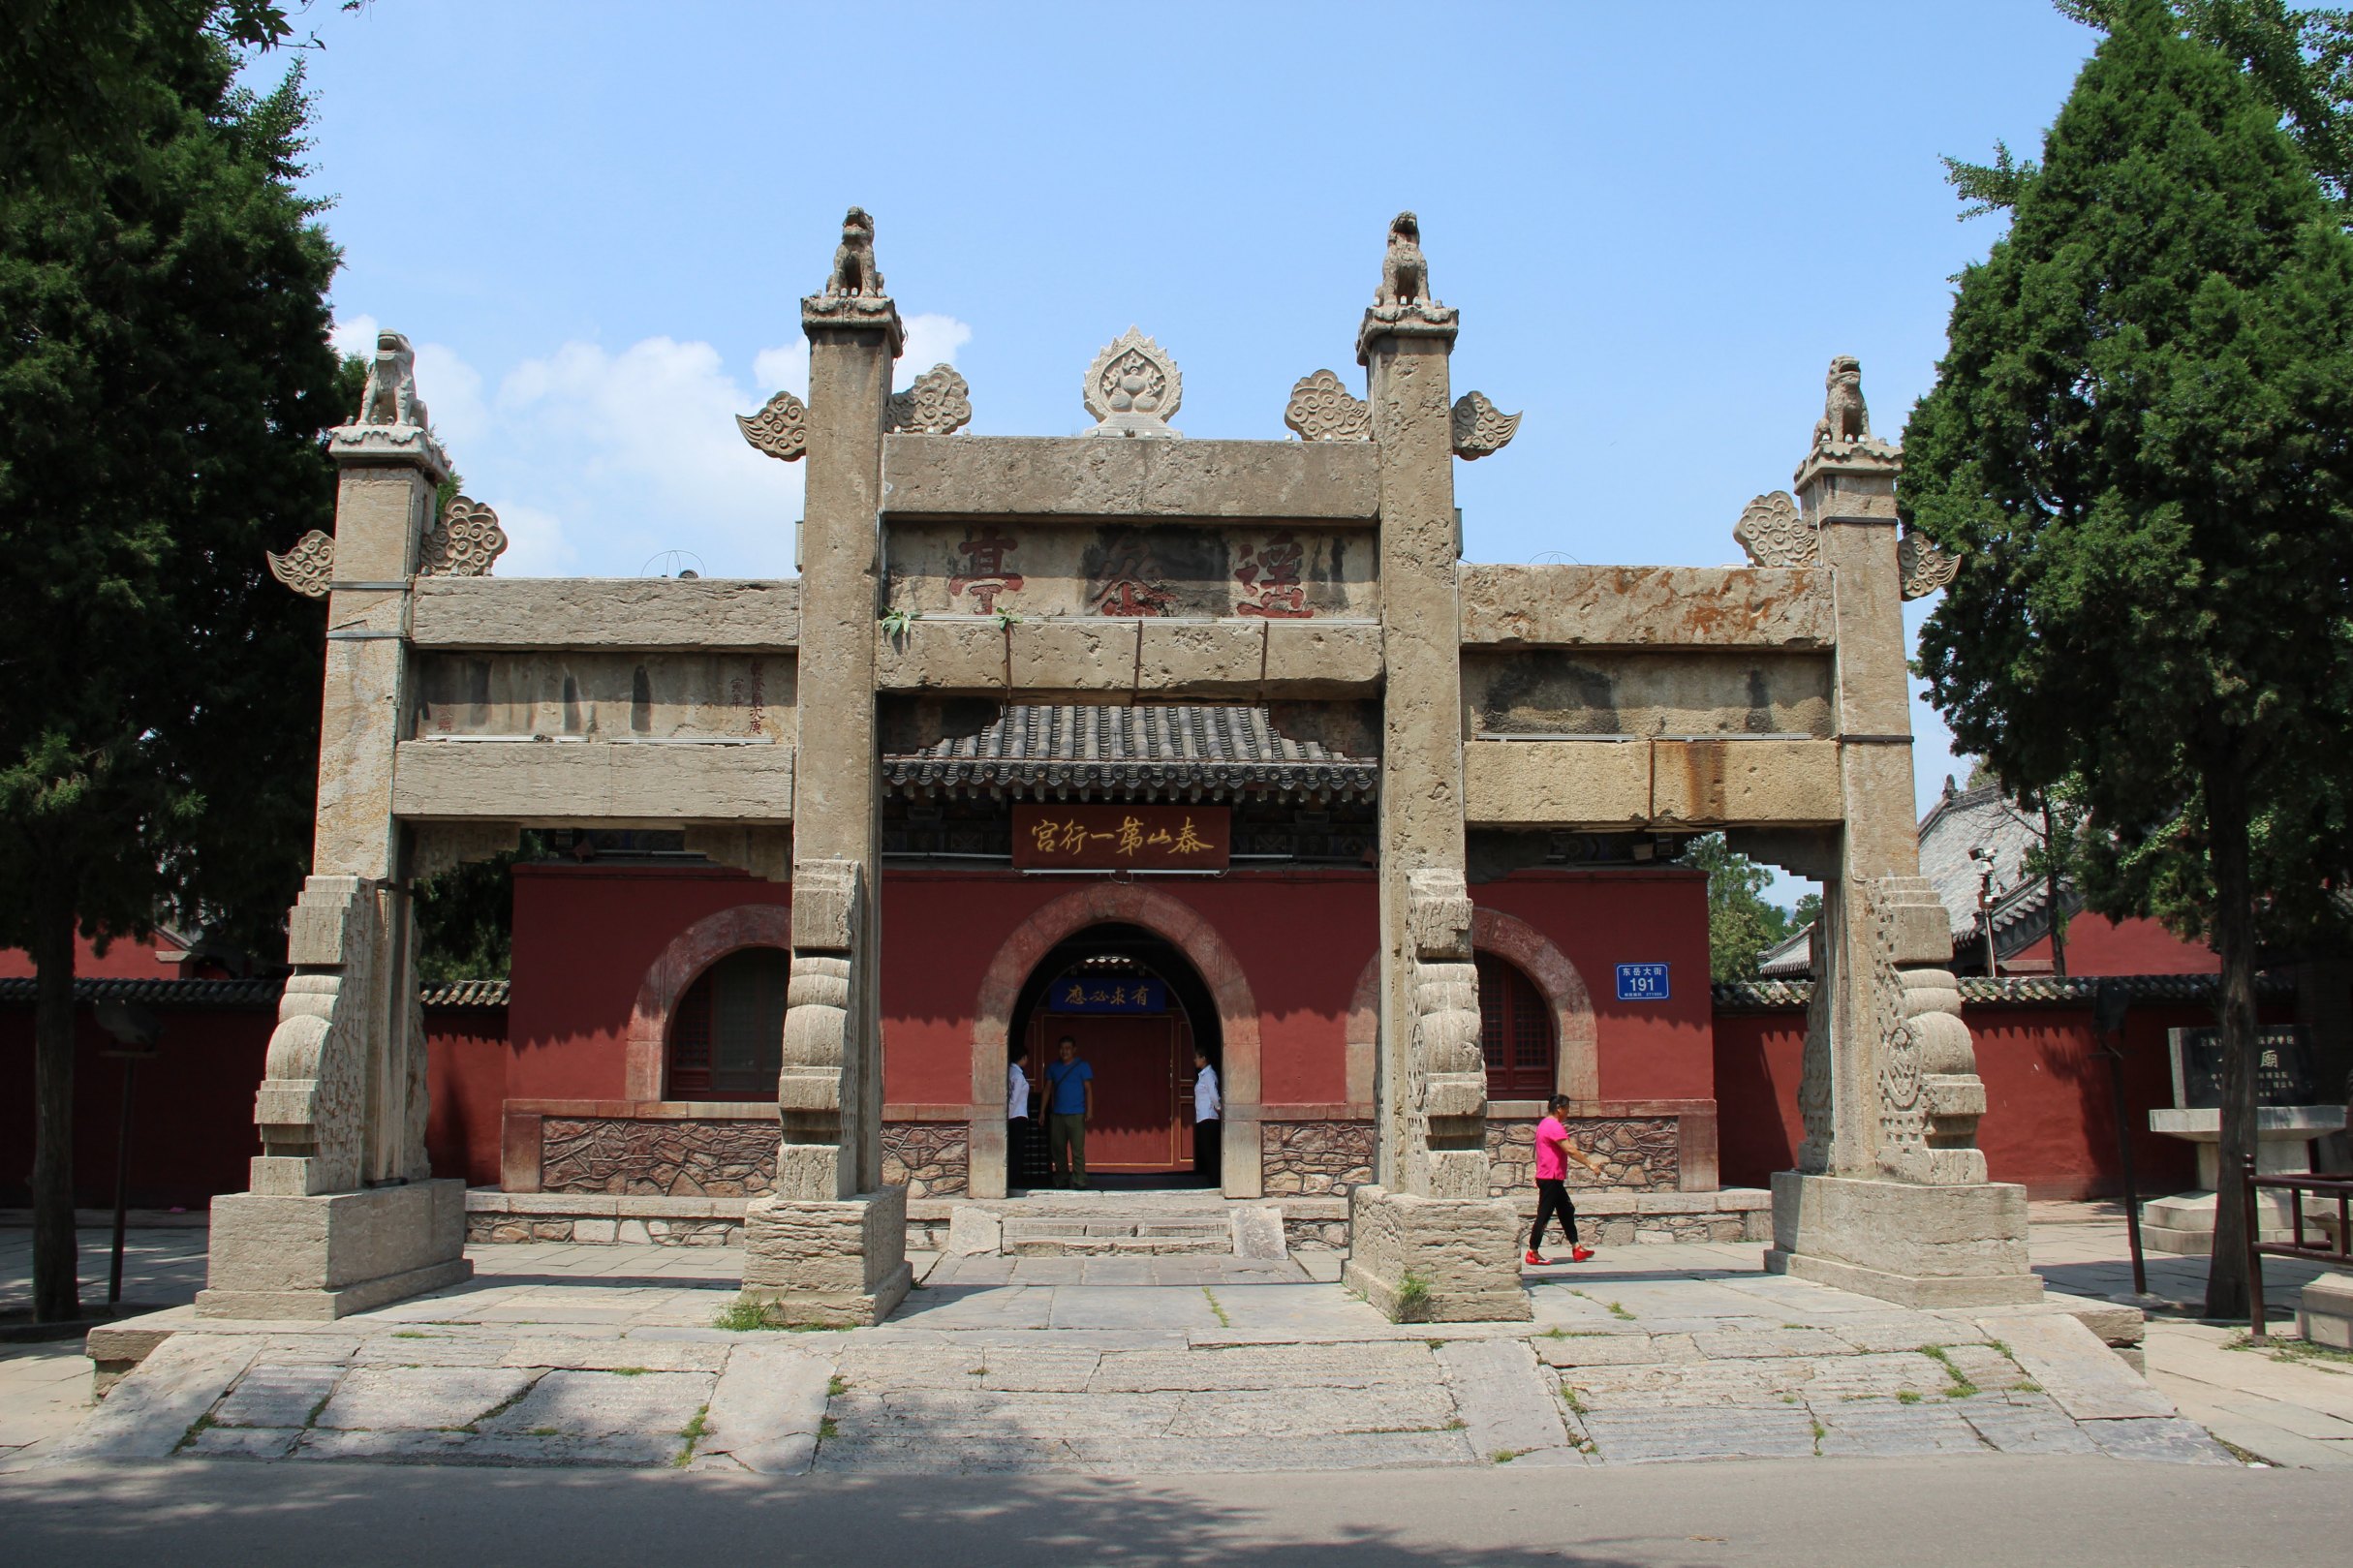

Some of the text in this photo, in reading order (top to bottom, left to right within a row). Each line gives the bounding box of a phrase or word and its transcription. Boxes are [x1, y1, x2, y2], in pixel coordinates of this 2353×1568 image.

[1623, 967, 1662, 976] 东岳大街
[1629, 977, 1655, 992] 191
